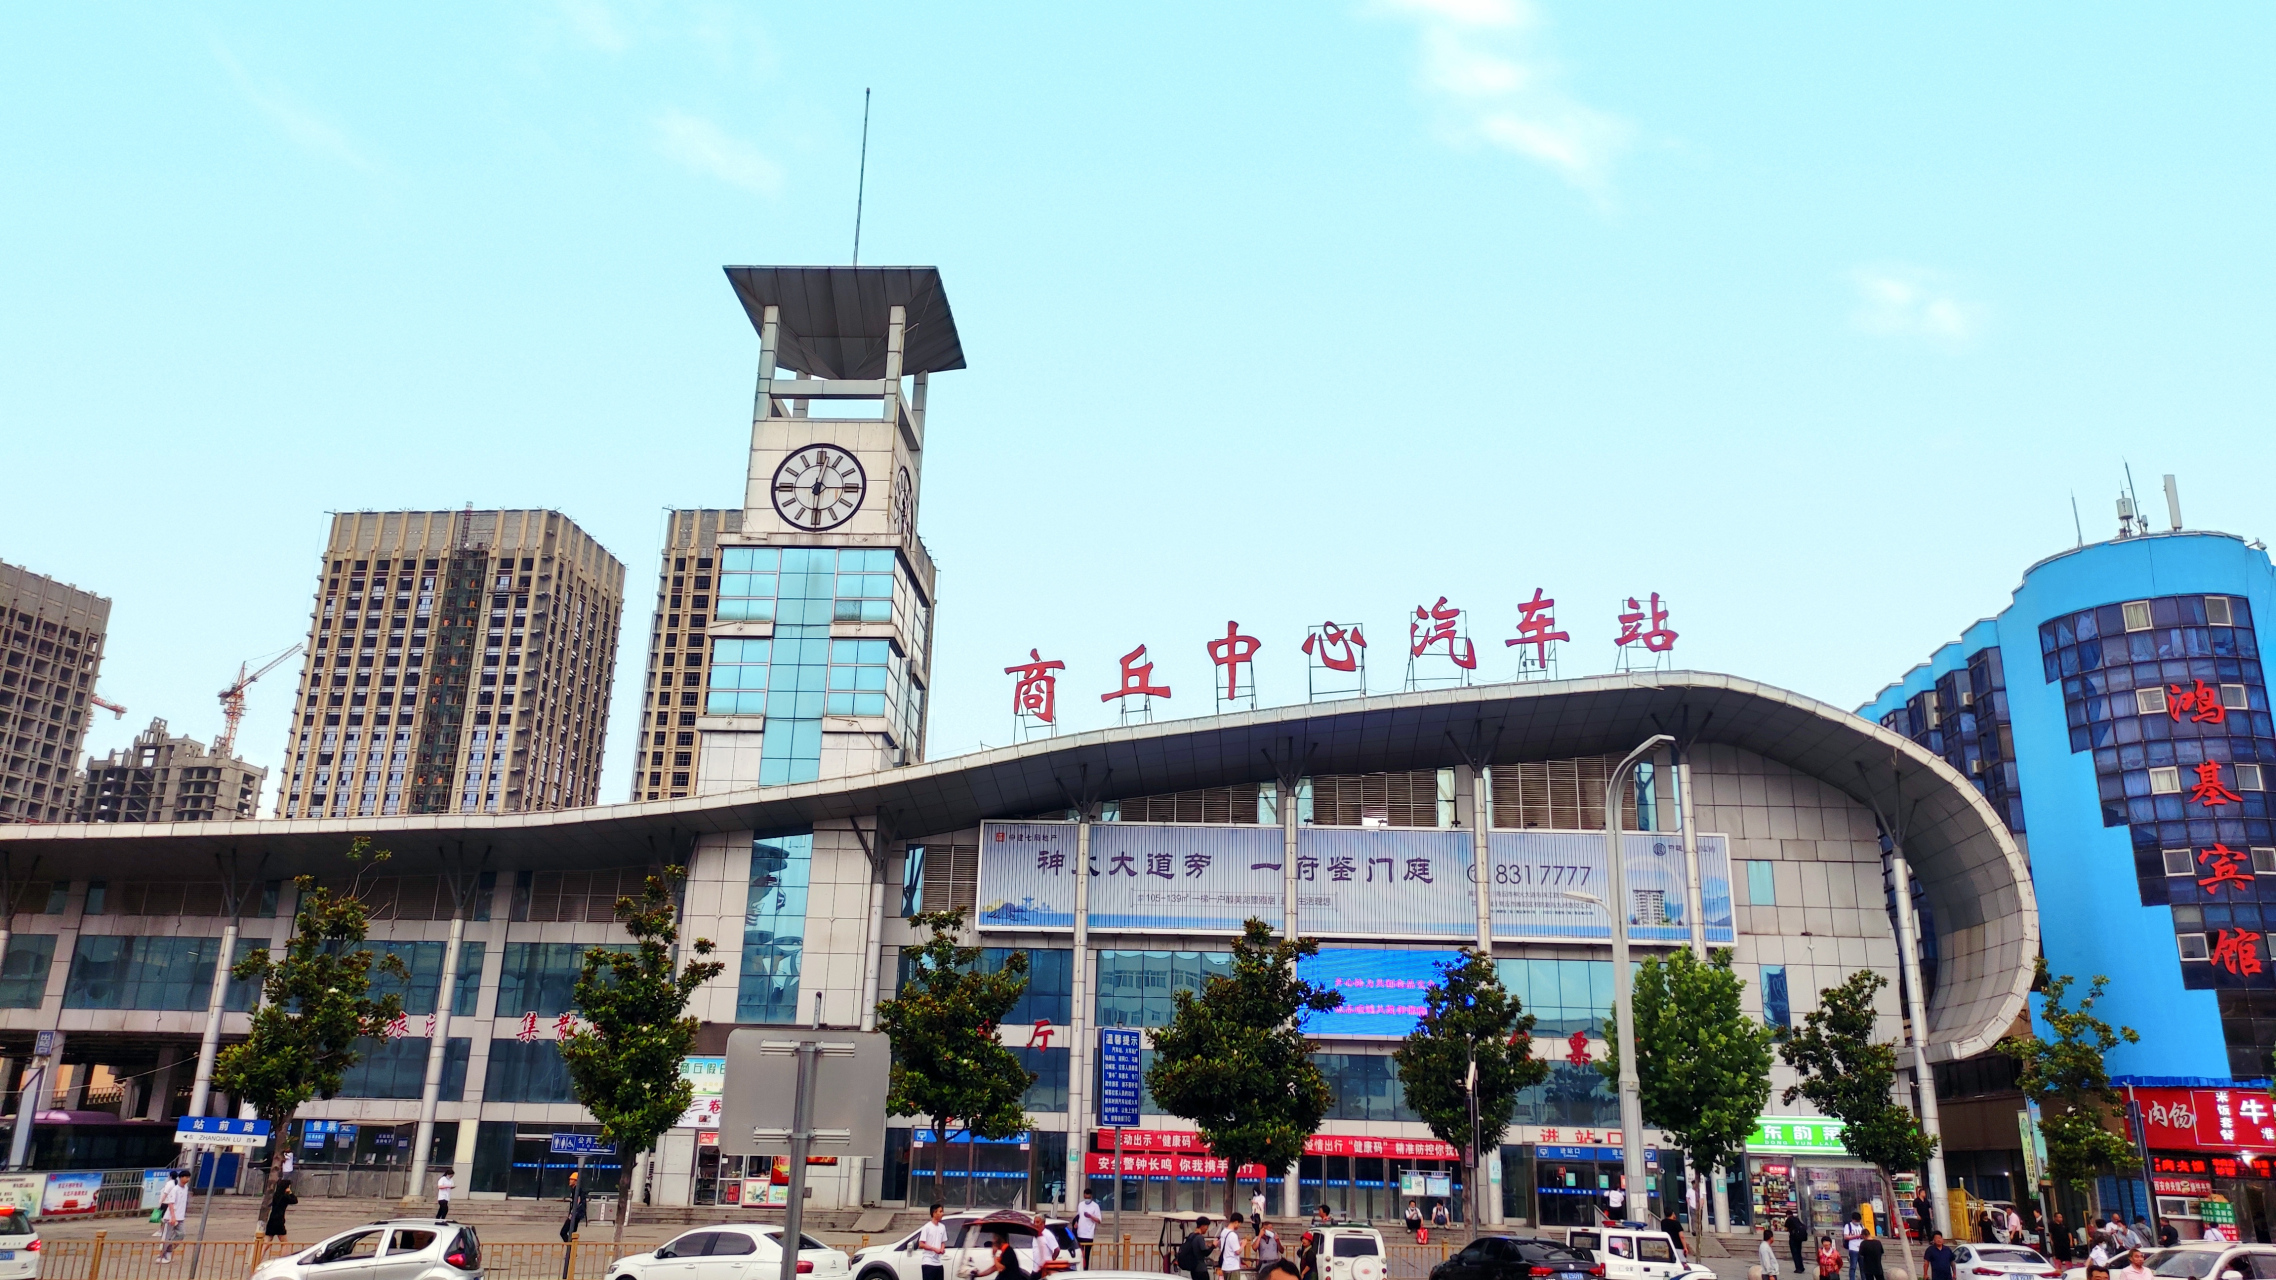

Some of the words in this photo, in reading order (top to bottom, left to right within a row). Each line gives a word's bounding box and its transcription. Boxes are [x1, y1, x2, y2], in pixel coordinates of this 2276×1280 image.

[1005, 588, 1679, 721] 商丘中心汽车站
[2167, 679, 2262, 977] 鸿基宾馆
[1496, 864, 1591, 886] 8317777
[1106, 1034, 1138, 1047] 温馨提示
[2215, 1091, 2234, 1141] 米饭套餐
[193, 1119, 255, 1133] 站前路
[1114, 1134, 1152, 1145] 动出示
[1540, 1129, 1623, 1144] 进站口
[1179, 1158, 1254, 1173] 你我携手行
